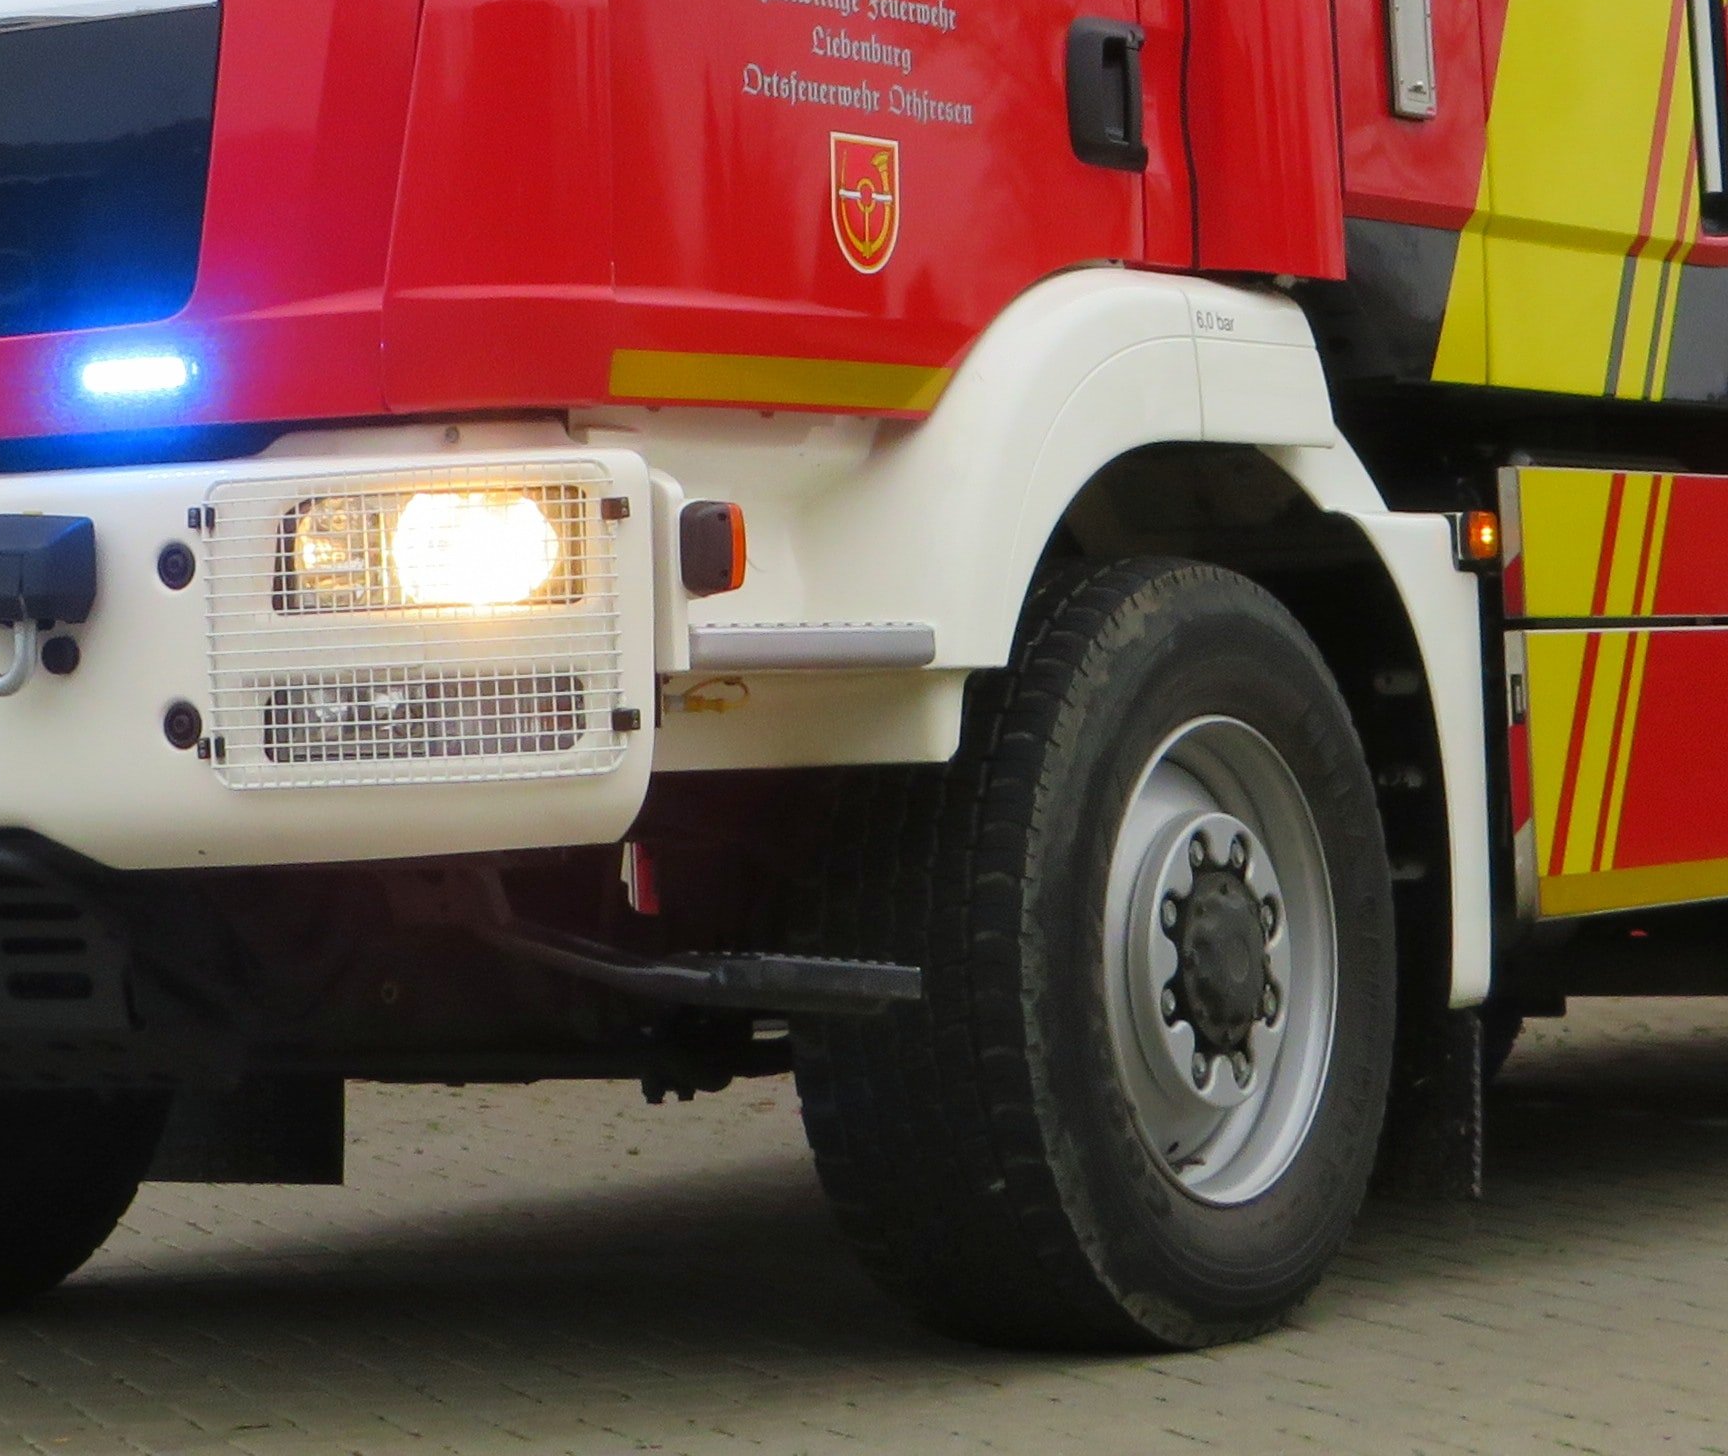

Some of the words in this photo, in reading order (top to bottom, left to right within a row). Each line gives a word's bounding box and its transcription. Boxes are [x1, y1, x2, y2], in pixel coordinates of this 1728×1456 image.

[812, 24, 912, 75] Liebenburg
[742, 62, 880, 115] Ortsfeuerwehr
[888, 83, 974, 125] Othfresen
[1195, 309, 1214, 332] 6,0
[1215, 311, 1235, 332] bar
